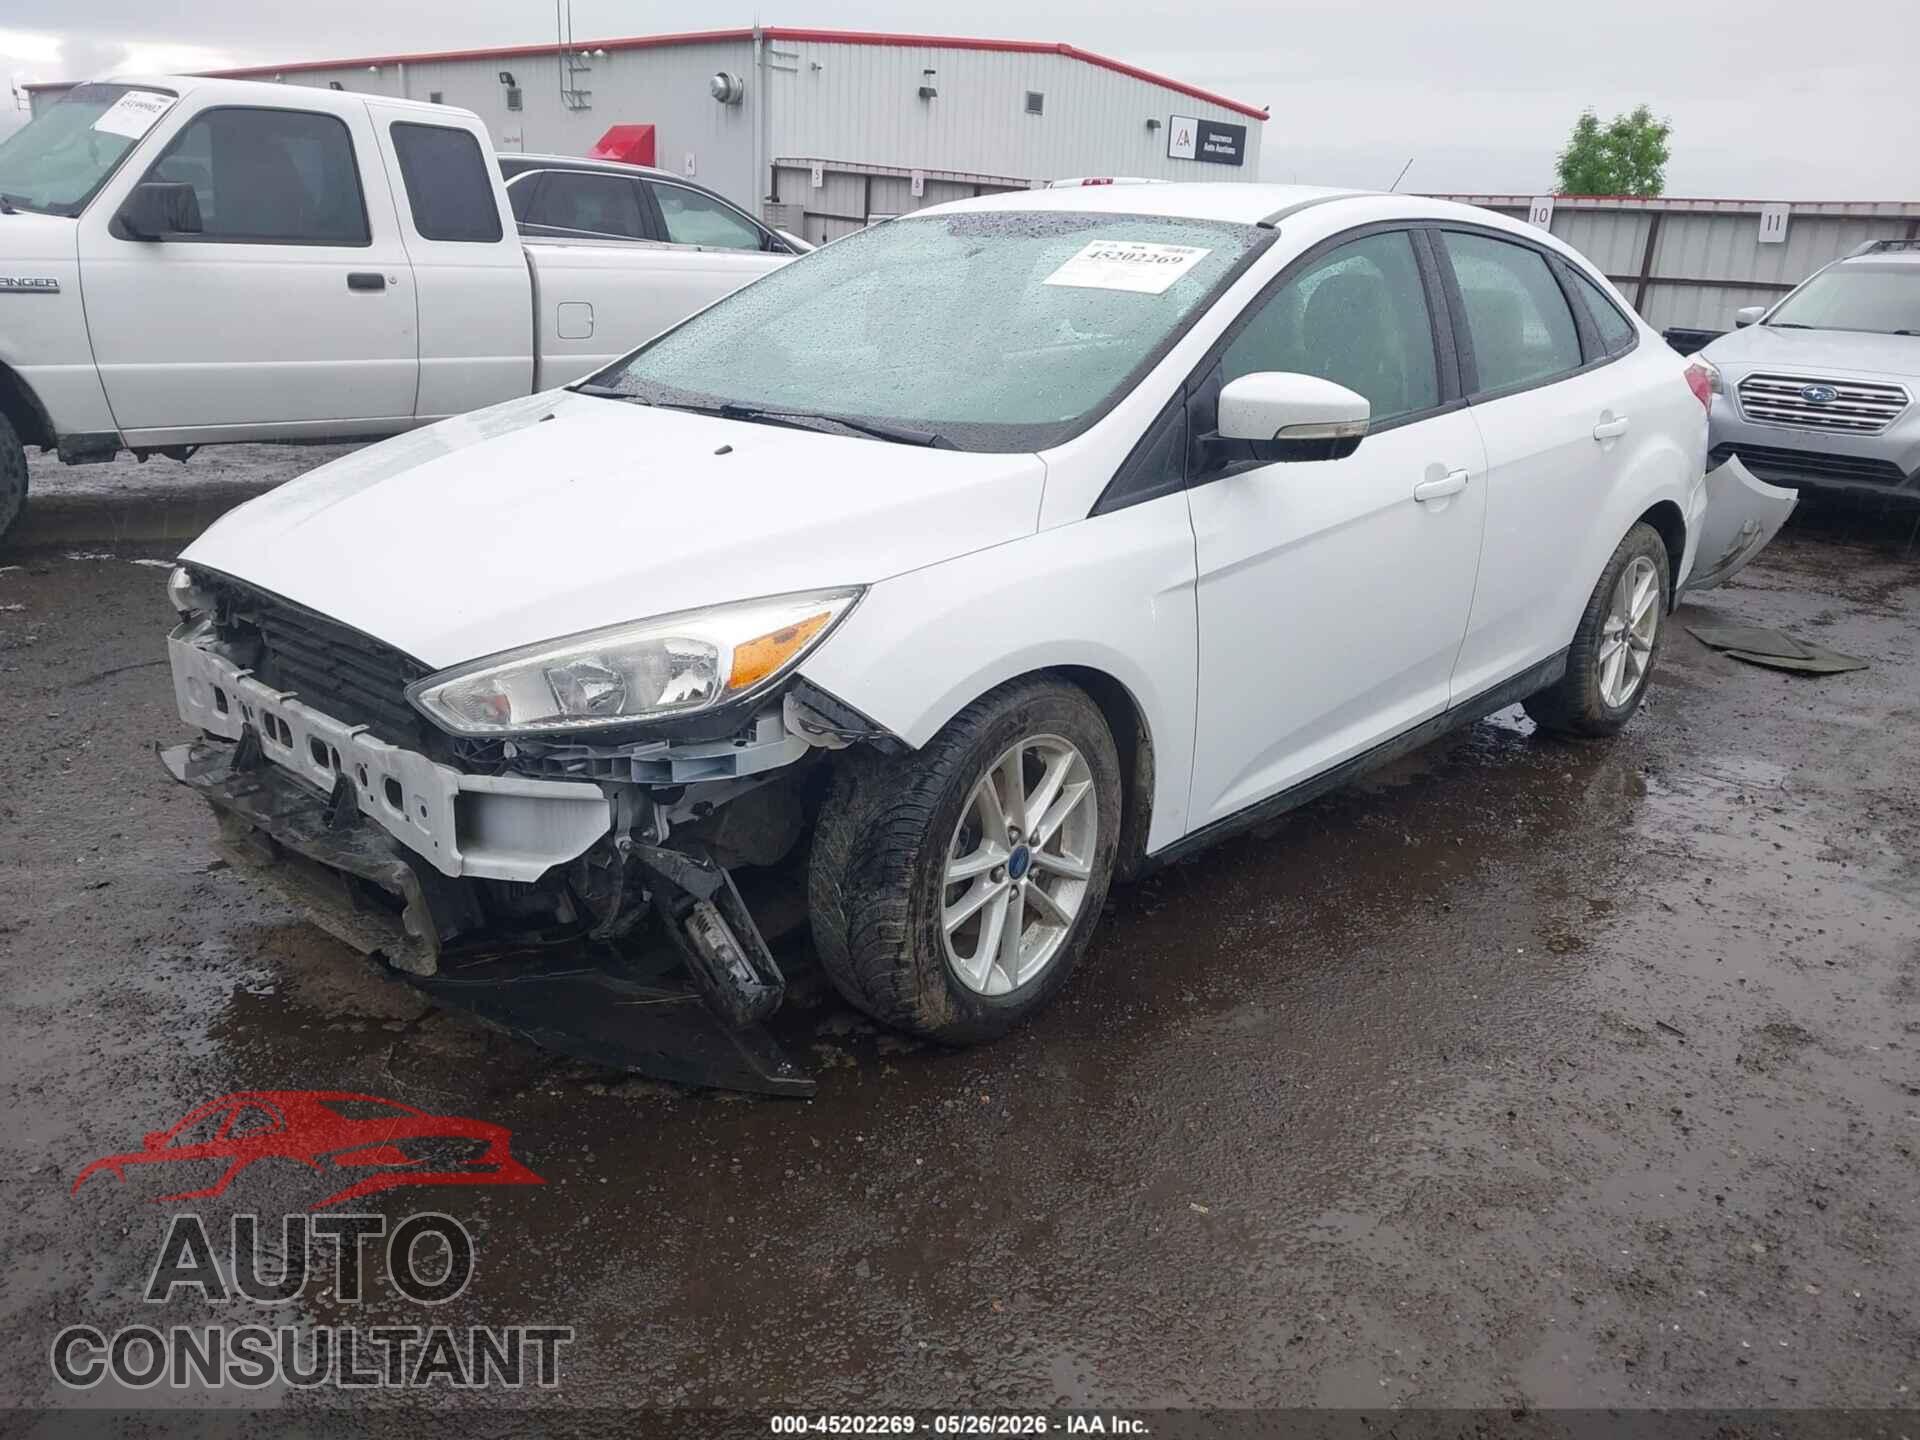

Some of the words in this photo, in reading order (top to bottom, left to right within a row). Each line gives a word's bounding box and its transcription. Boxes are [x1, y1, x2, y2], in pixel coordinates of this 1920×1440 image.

[815, 168, 820, 180] 5
[1533, 207, 1548, 223] 10
[1767, 214, 1780, 231] 11
[1087, 250, 1184, 265] 45202269
